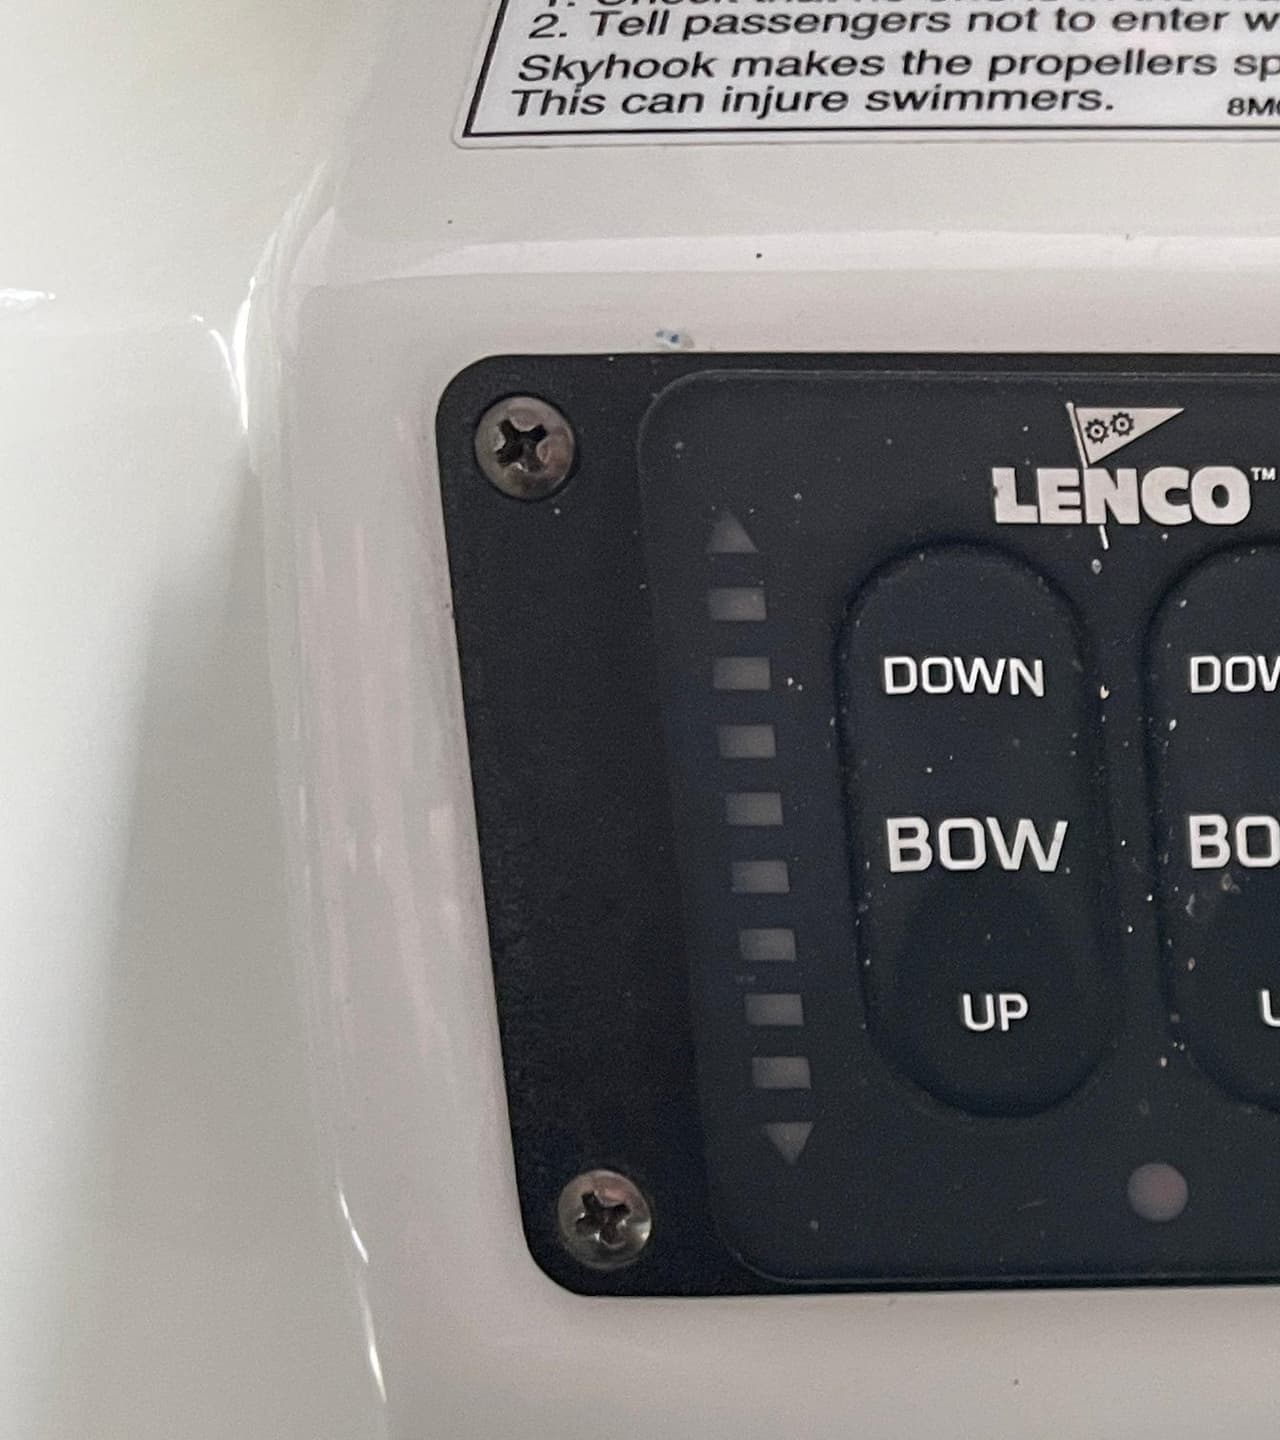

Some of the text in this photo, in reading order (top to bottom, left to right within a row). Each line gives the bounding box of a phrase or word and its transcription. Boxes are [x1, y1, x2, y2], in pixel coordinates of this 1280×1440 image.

[528, 13, 567, 39] 2.
[590, 9, 670, 36] Tell
[682, 10, 952, 41] passengers
[967, 8, 1038, 33] not
[1055, 8, 1095, 33] to
[1111, 8, 1231, 33] enter
[518, 51, 717, 87] Skyhook
[731, 50, 885, 78] makes
[902, 49, 972, 77] the
[988, 48, 1218, 82] propellers
[512, 85, 1115, 120] This can injure swimmers.
[884, 656, 1045, 697] DOWN
[887, 817, 1068, 873] BOW
[962, 994, 1029, 1031] UP
